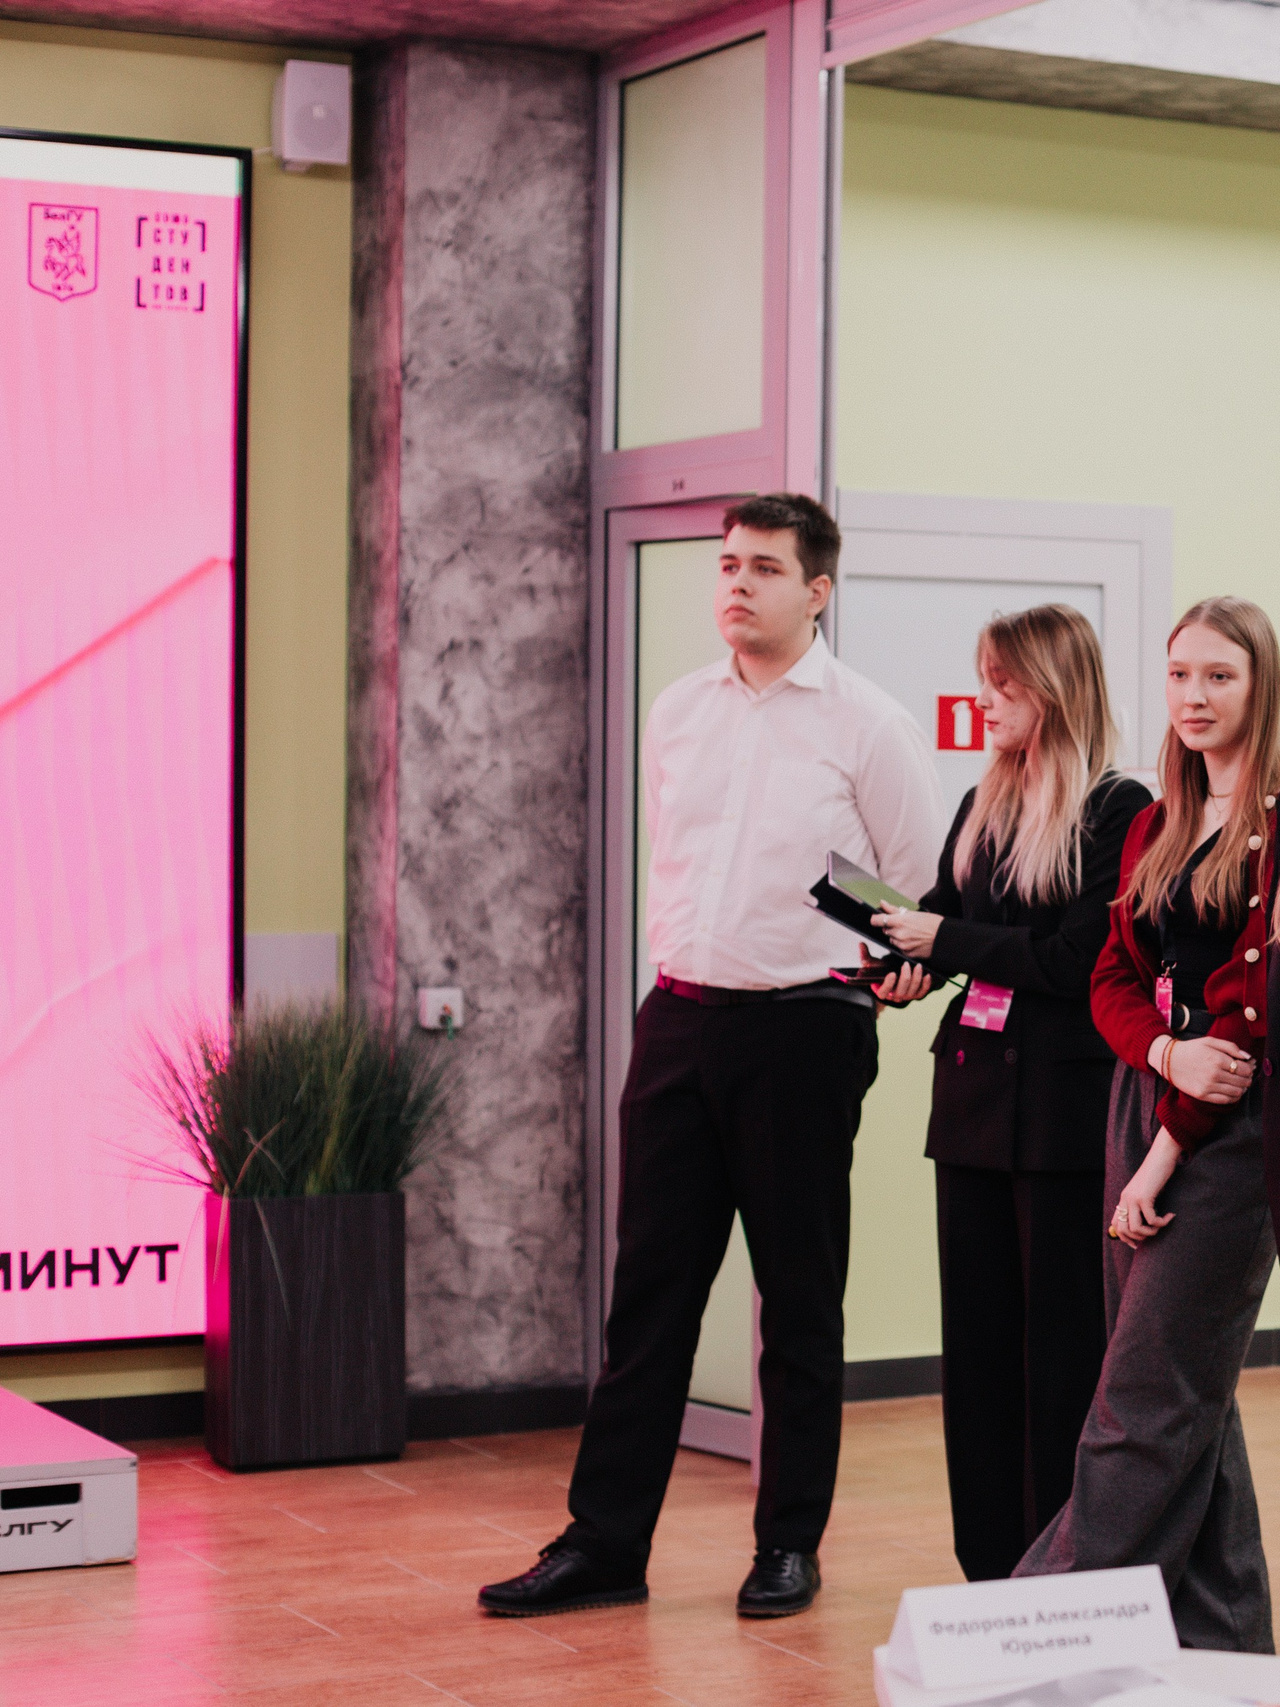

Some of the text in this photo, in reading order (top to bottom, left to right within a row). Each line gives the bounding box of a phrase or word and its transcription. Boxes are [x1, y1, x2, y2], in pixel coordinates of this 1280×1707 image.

[0, 1244, 179, 1291] ИНУТ
[0, 1518, 74, 1537] ЛГУ
[930, 1603, 1150, 1636] Федорова Александра
[1002, 1634, 1092, 1656] Юрьевна
